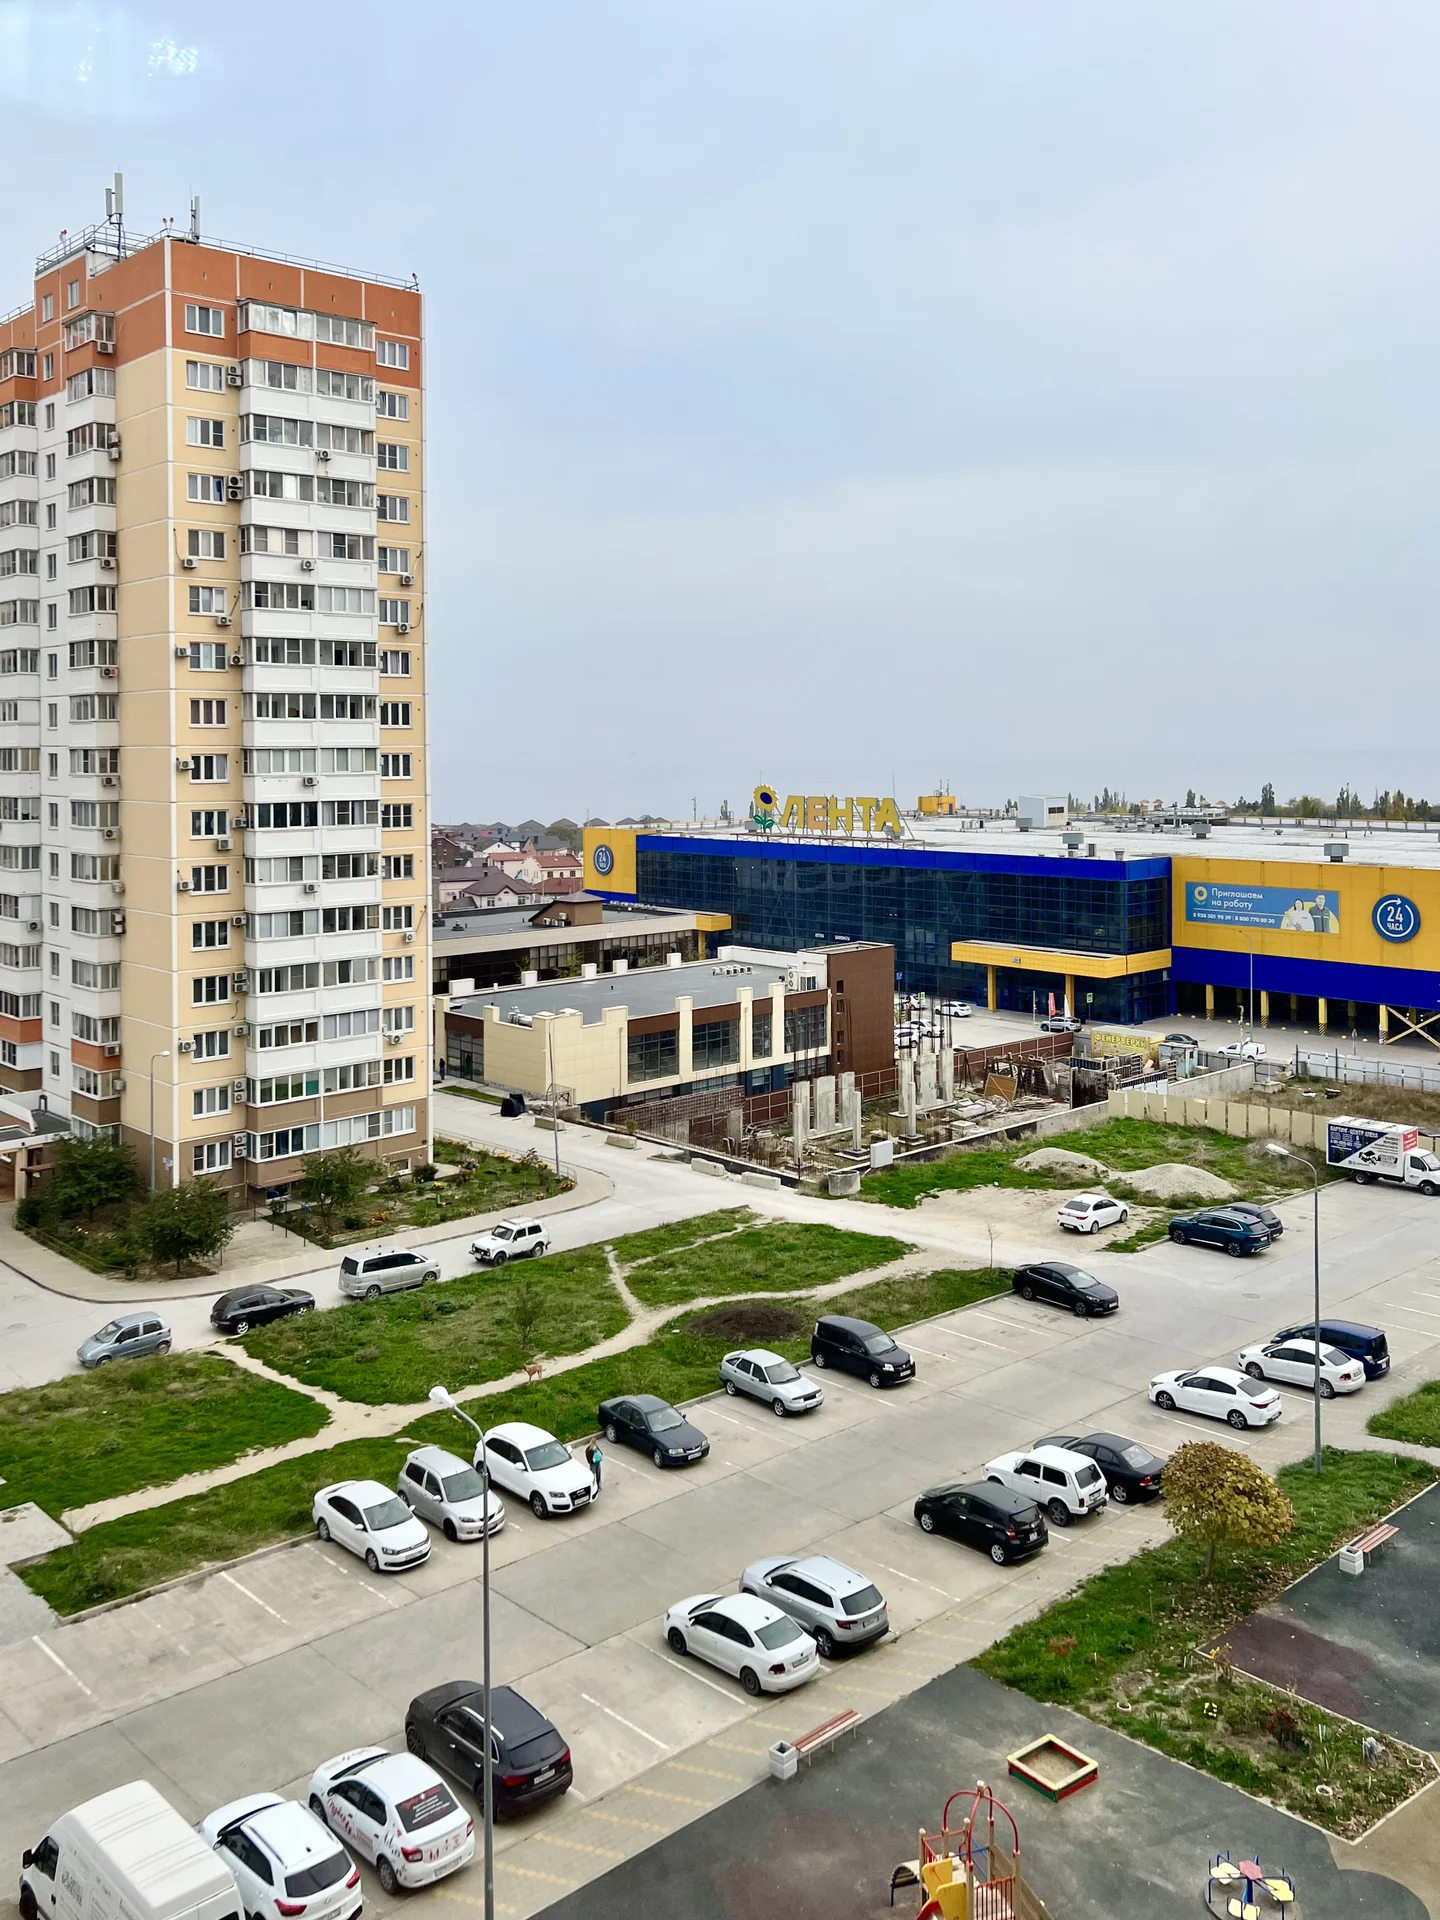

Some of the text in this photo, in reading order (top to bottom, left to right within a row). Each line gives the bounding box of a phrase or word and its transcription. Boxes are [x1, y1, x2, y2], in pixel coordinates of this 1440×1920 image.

[780, 795, 901, 832] ЛЕНТА
[1211, 888, 1263, 899] Приглашаем
[1223, 899, 1253, 910] работу
[1387, 906, 1404, 922] 24
[1386, 922, 1403, 931] ЧАСА
[1095, 1033, 1145, 1047] ФЕЙЕРВЕРКИ
